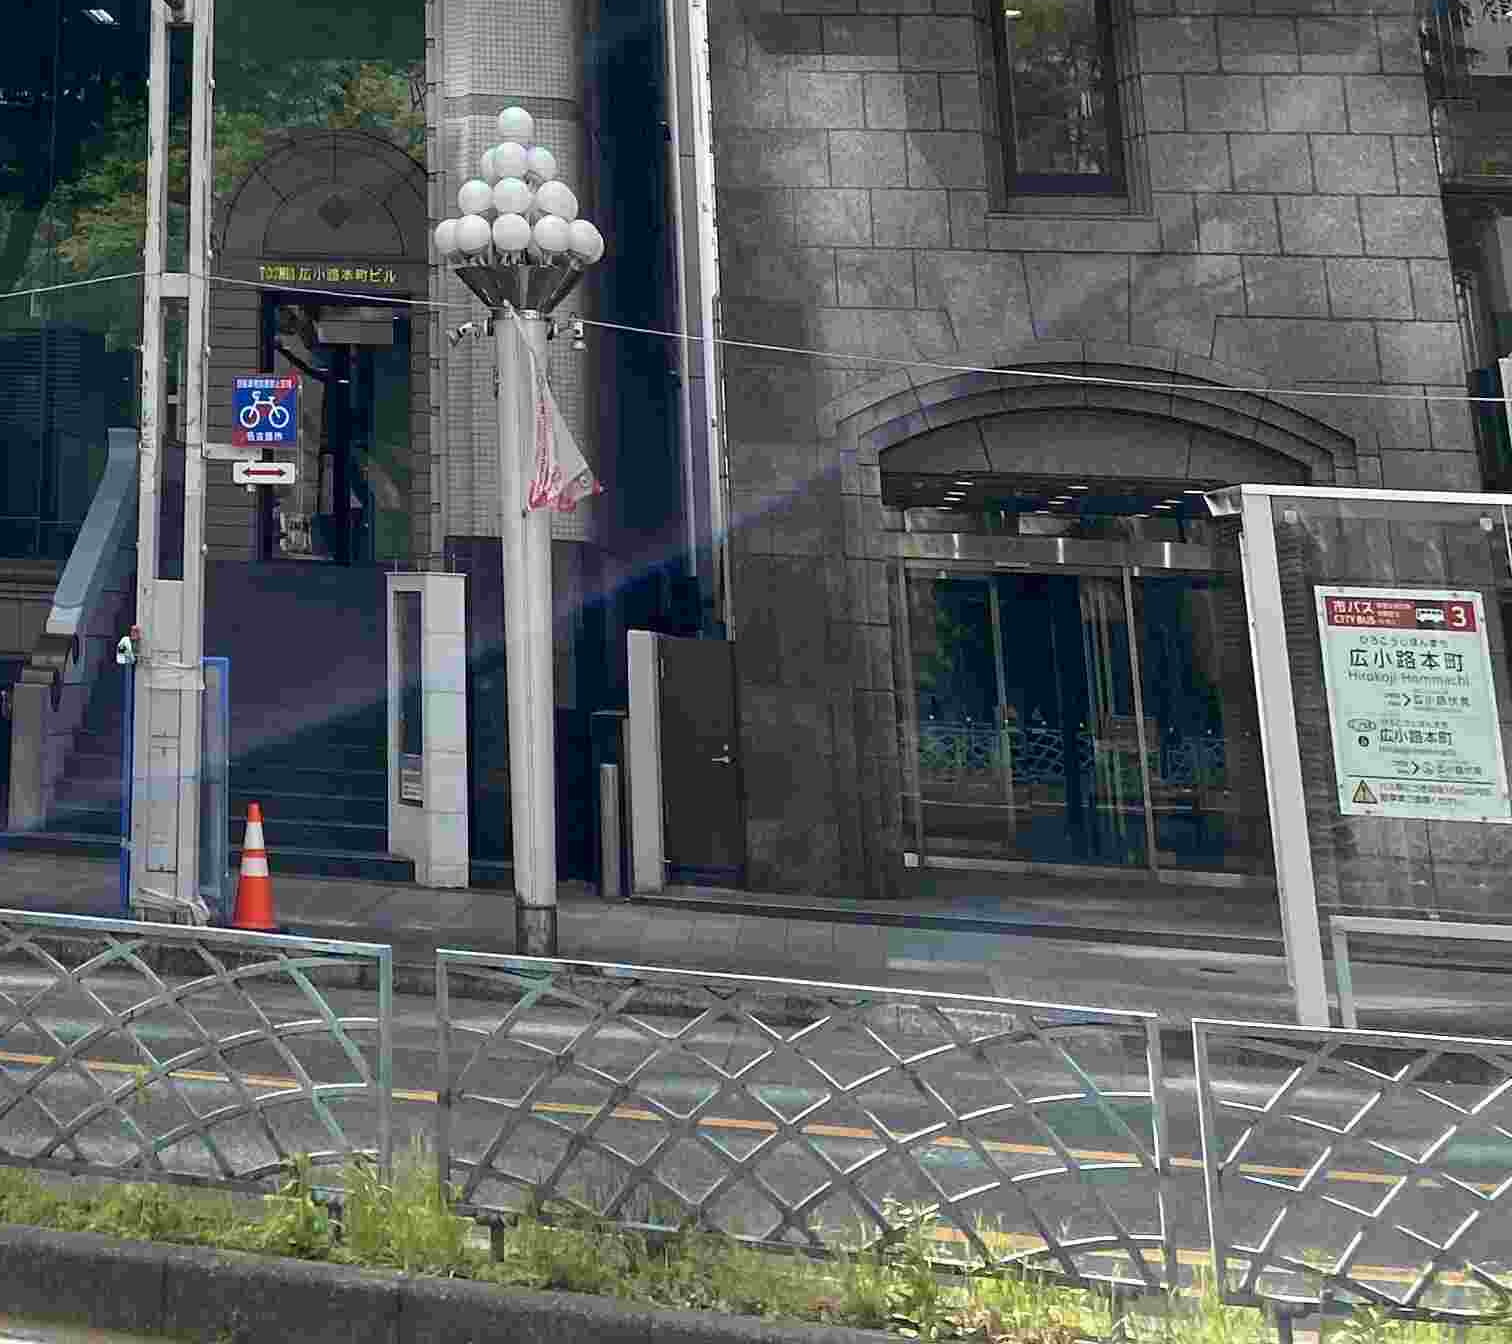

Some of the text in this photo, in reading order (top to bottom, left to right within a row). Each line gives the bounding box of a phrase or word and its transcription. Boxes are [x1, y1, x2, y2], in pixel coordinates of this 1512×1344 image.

[1333, 600, 1374, 615] 市バス
[1450, 605, 1467, 627] 3
[1333, 614, 1376, 625] CITY BUS
[1349, 647, 1465, 672] 広小路本町
